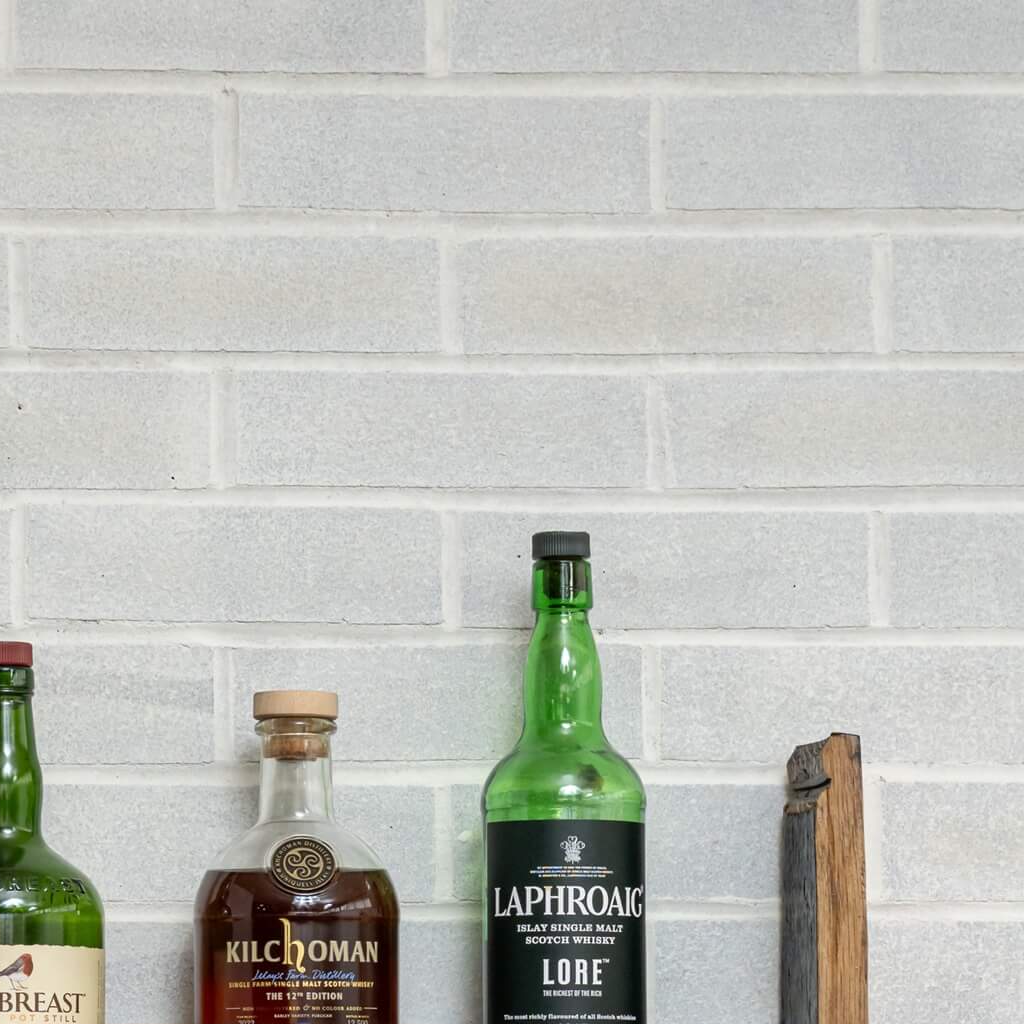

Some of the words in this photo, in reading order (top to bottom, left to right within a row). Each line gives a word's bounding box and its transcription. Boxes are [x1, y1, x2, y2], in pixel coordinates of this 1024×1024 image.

[494, 885, 643, 918] LAPHROAIG
[517, 924, 547, 933] ISLAY
[550, 924, 593, 932] SINGLE
[595, 924, 624, 933] MALT
[525, 936, 570, 945] SCOTCH
[573, 936, 616, 945] WHISKY
[265, 992, 283, 1001] THE
[306, 992, 343, 1000] EDITION
[43, 1014, 77, 1023] STILL
